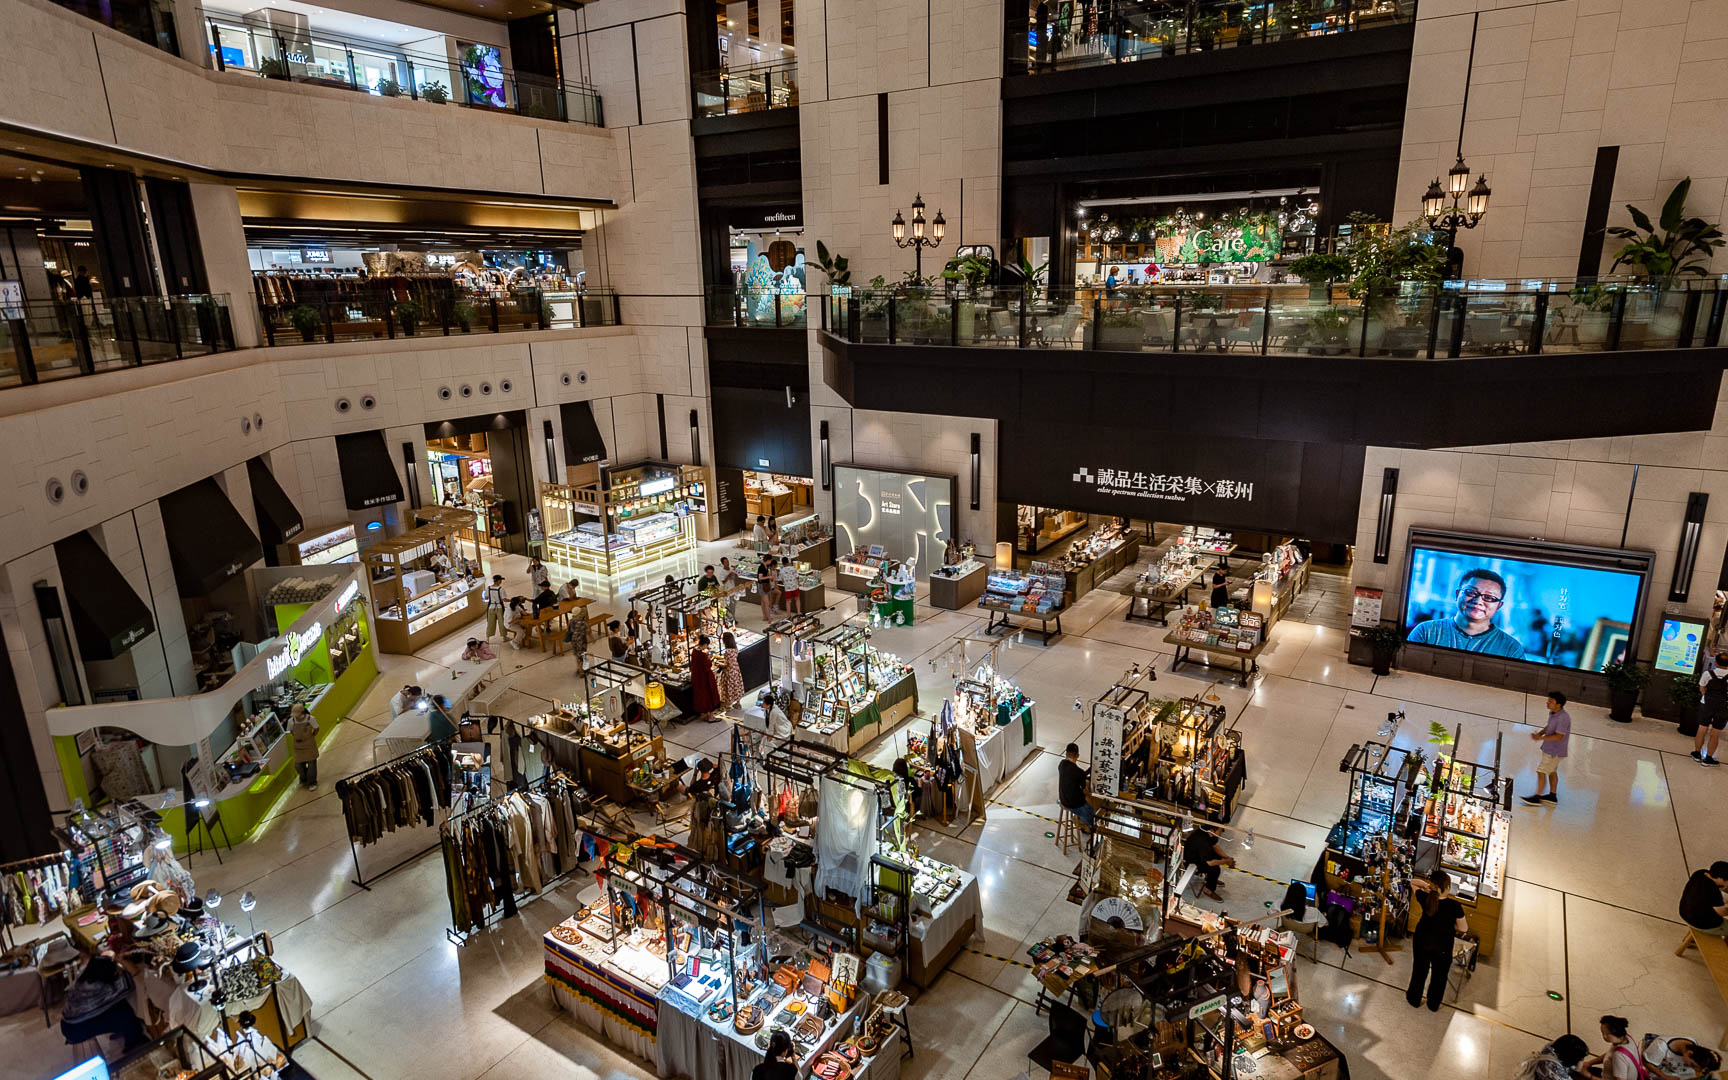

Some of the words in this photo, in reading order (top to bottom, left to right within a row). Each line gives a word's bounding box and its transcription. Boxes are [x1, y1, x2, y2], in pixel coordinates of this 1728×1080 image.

[764, 212, 796, 221] onefifteen
[1097, 468, 1254, 501] 誠品生活采集×蘇州
[1136, 491, 1164, 499] collection
